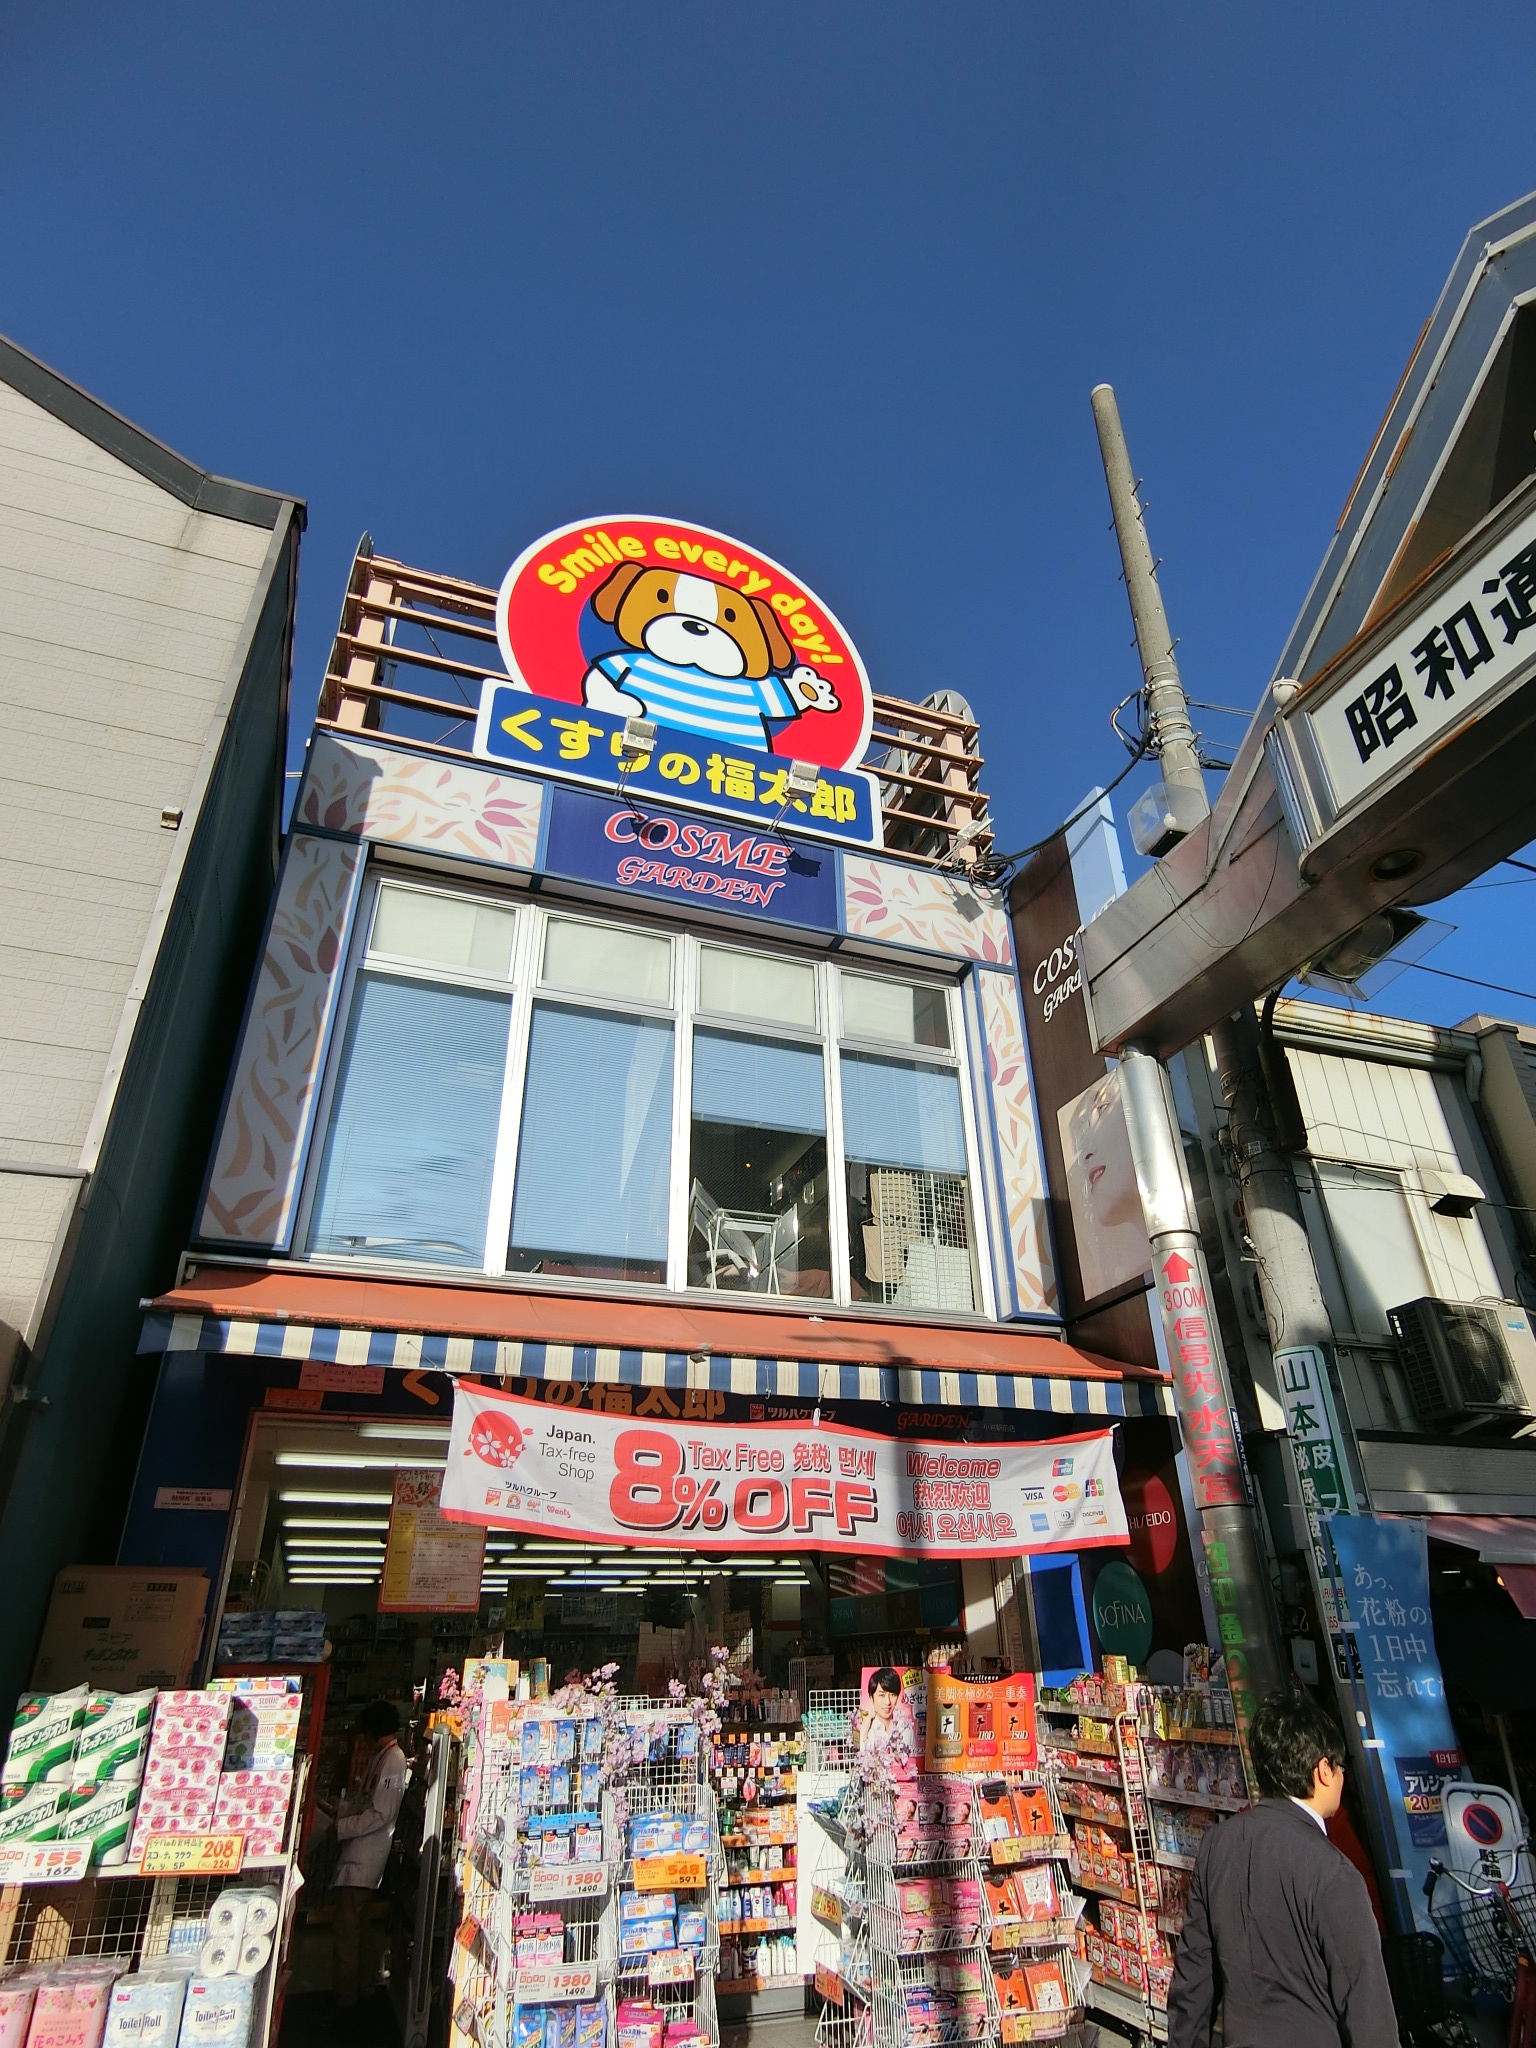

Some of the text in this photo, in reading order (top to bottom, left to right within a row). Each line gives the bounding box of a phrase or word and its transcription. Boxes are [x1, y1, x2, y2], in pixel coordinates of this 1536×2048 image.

[538, 531, 843, 665] Smile every day!
[605, 809, 796, 876] COSME
[616, 855, 786, 908] GARDEN
[1164, 1286, 1206, 1312] 300M
[1281, 1359, 1320, 1437] 山本
[1173, 1316, 1241, 1503] 信号先水天宮
[897, 1412, 970, 1431] GARDEN
[546, 1424, 596, 1444] Japan.
[539, 1442, 596, 1463] Tax-free
[687, 1440, 877, 1479] Tax Free 免税 면세
[558, 1462, 595, 1483] Shop
[907, 1451, 1001, 1478] Welcome
[505, 1481, 557, 1500] ツルハグループ
[913, 1479, 991, 1510] 热烈欢迎
[1024, 1492, 1044, 1500] VISA
[546, 1504, 571, 1519] Wants
[896, 1512, 1016, 1542] 어서 오십시오
[1098, 1600, 1147, 1630] SOFINA
[1357, 1597, 1432, 1627] 花粉の
[1369, 1633, 1427, 1663] 1日中
[963, 1674, 999, 1682] excellence
[901, 1692, 928, 1705] めざせ
[935, 1686, 1028, 1700] 美脚を極める三重奏
[1409, 1794, 1430, 1811] 20
[202, 1840, 234, 1858] 208
[34, 1852, 82, 1867] 155
[46, 1867, 73, 1876] 167
[567, 1872, 603, 1887] 1380
[668, 1864, 700, 1876] 548
[578, 1884, 598, 1893] 1490
[679, 1876, 697, 1884] 591
[553, 1973, 591, 1988] 1380
[565, 1986, 586, 1996] 1490
[119, 2015, 161, 2030] Toilet Roll
[195, 2010, 217, 2023] Toilet
